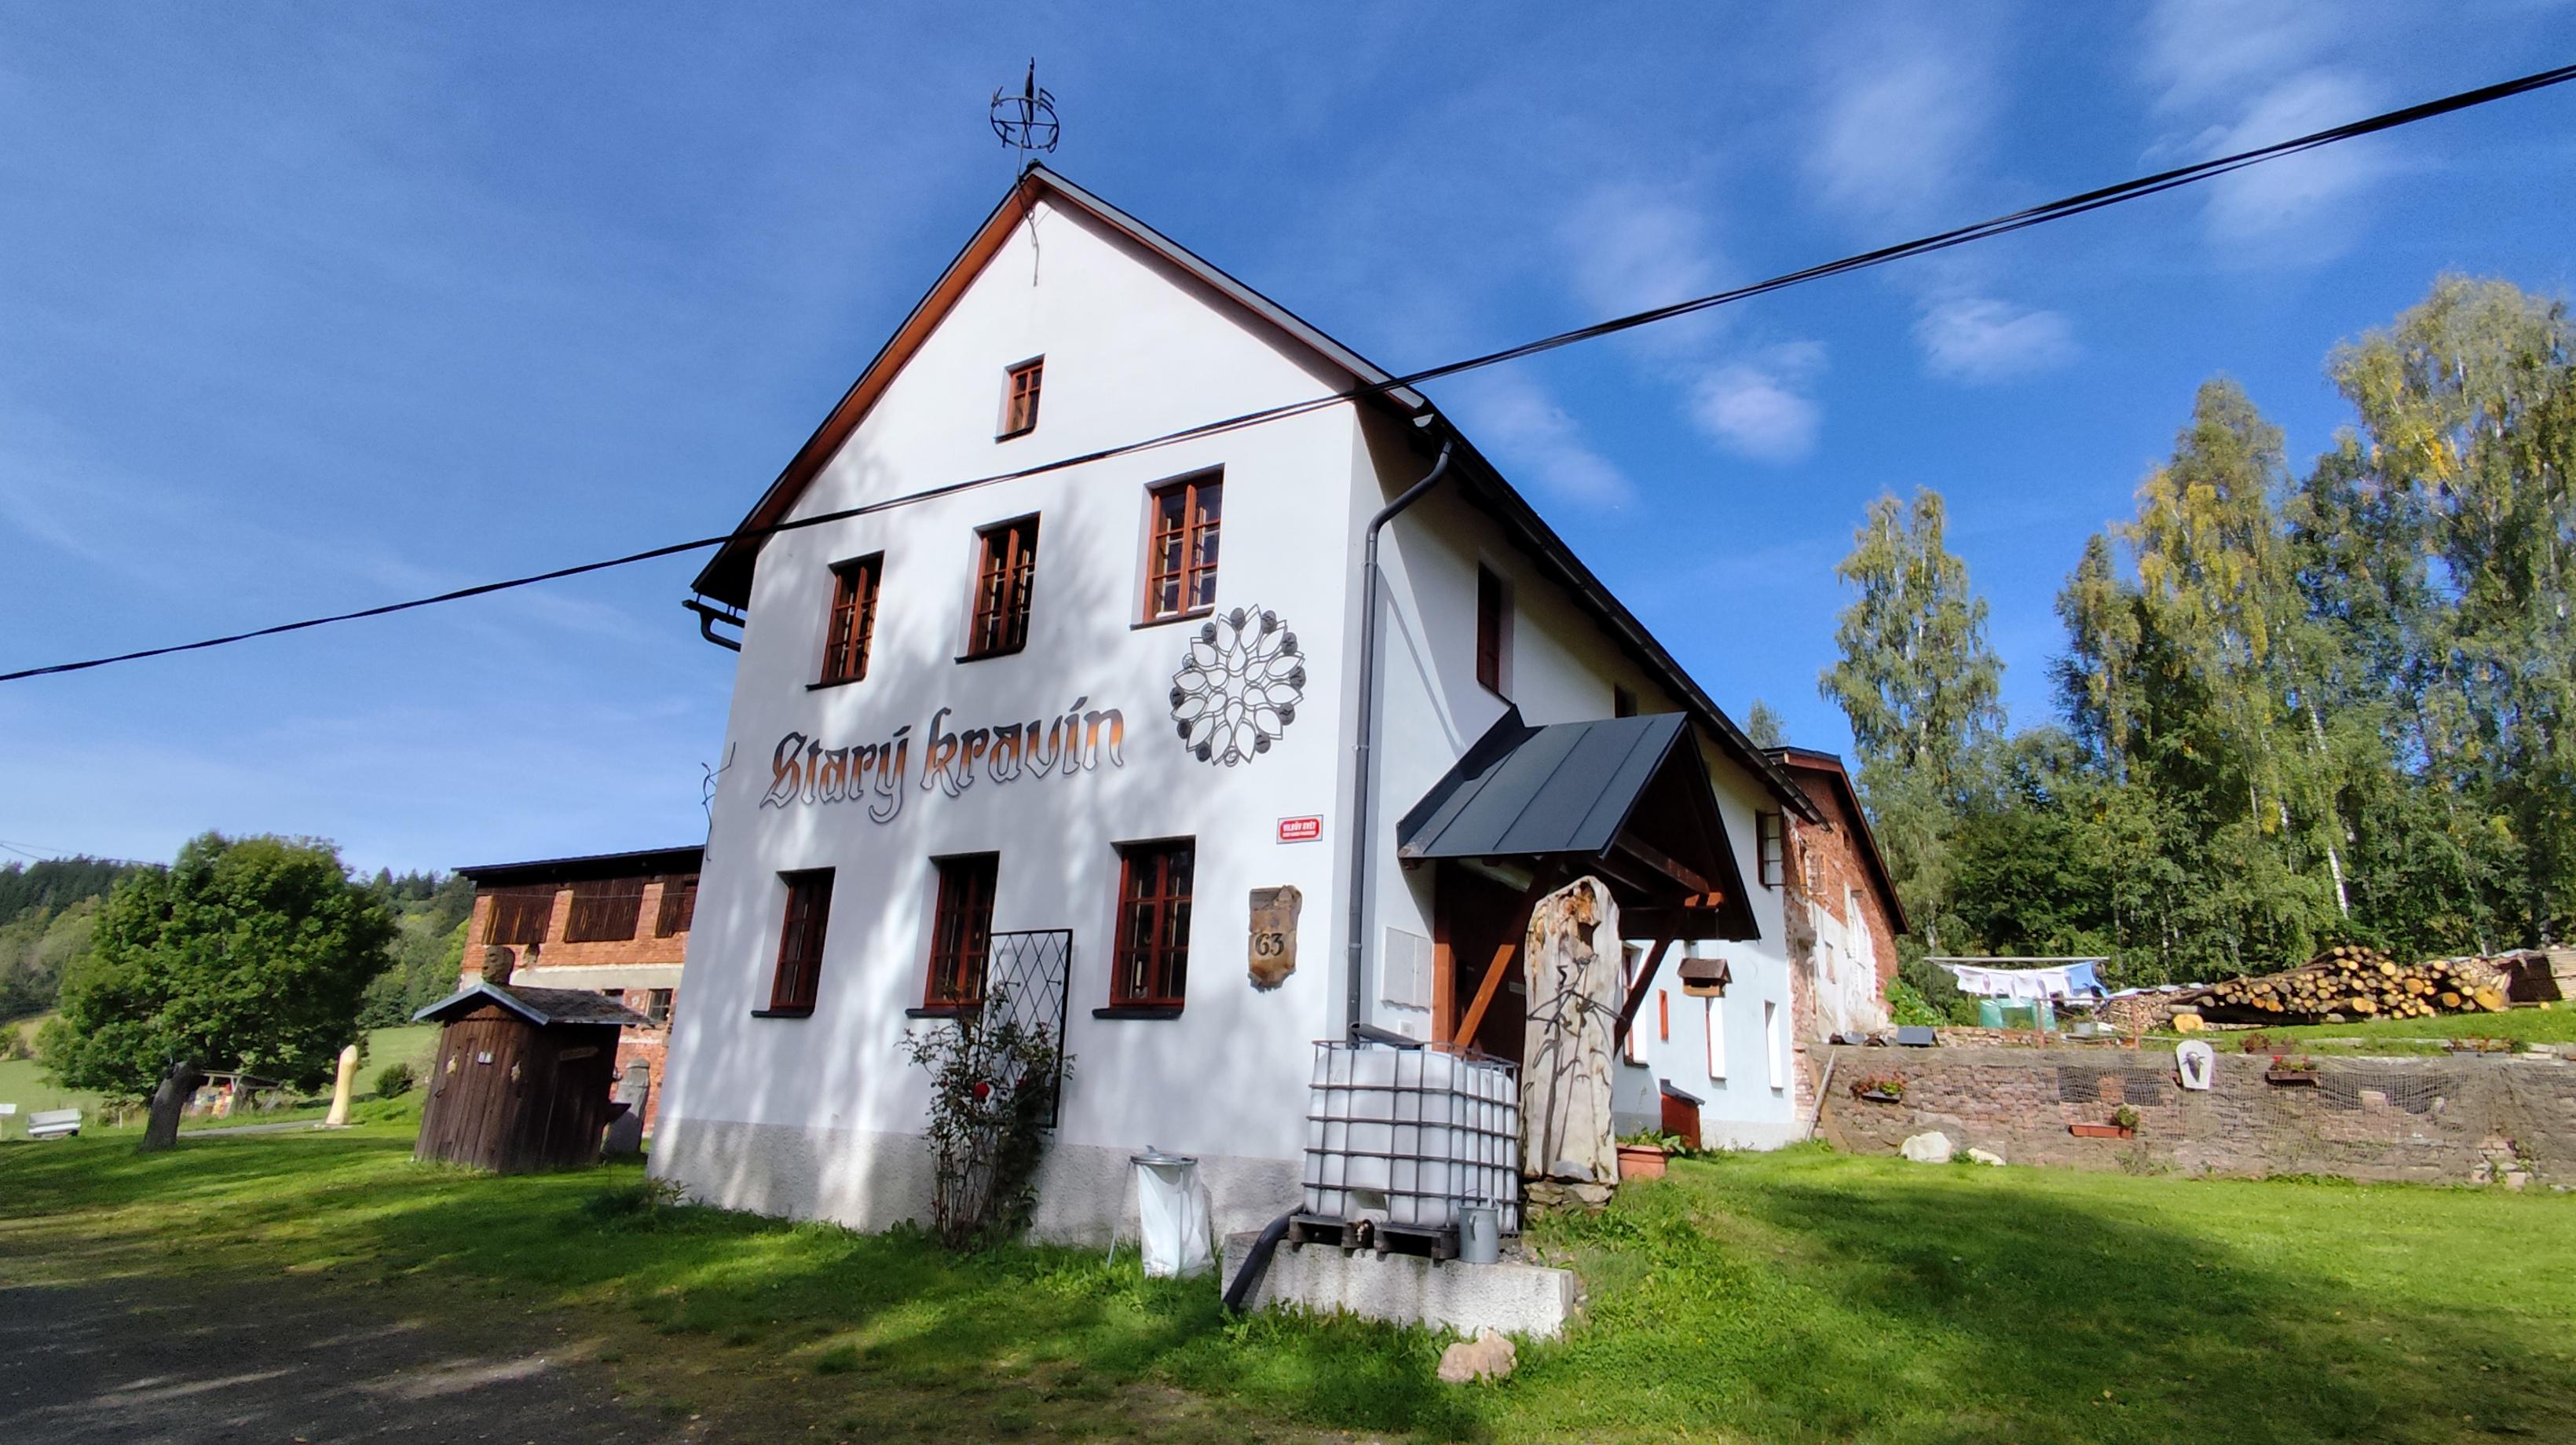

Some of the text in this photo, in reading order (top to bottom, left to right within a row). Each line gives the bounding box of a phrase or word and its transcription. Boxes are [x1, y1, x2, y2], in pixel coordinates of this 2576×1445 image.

[759, 696, 1125, 824] Starý kravín
[1255, 932, 1285, 957] 63
